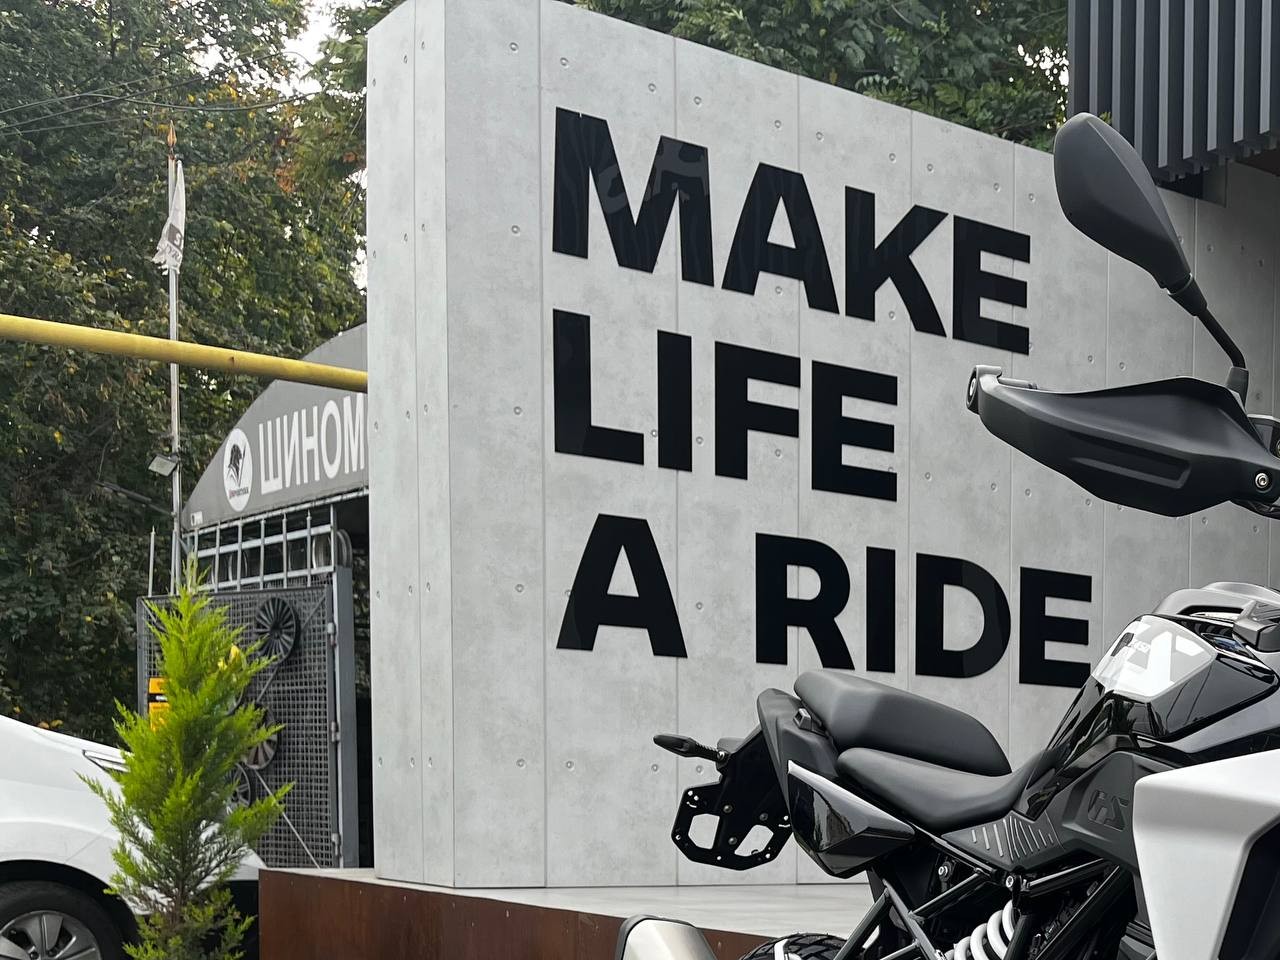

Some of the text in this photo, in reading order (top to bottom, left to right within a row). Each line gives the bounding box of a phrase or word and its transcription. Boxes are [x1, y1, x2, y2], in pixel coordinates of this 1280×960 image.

[552, 106, 1031, 356] MAKE
[552, 308, 898, 502] LIFE
[556, 512, 1093, 688] A RIDE
